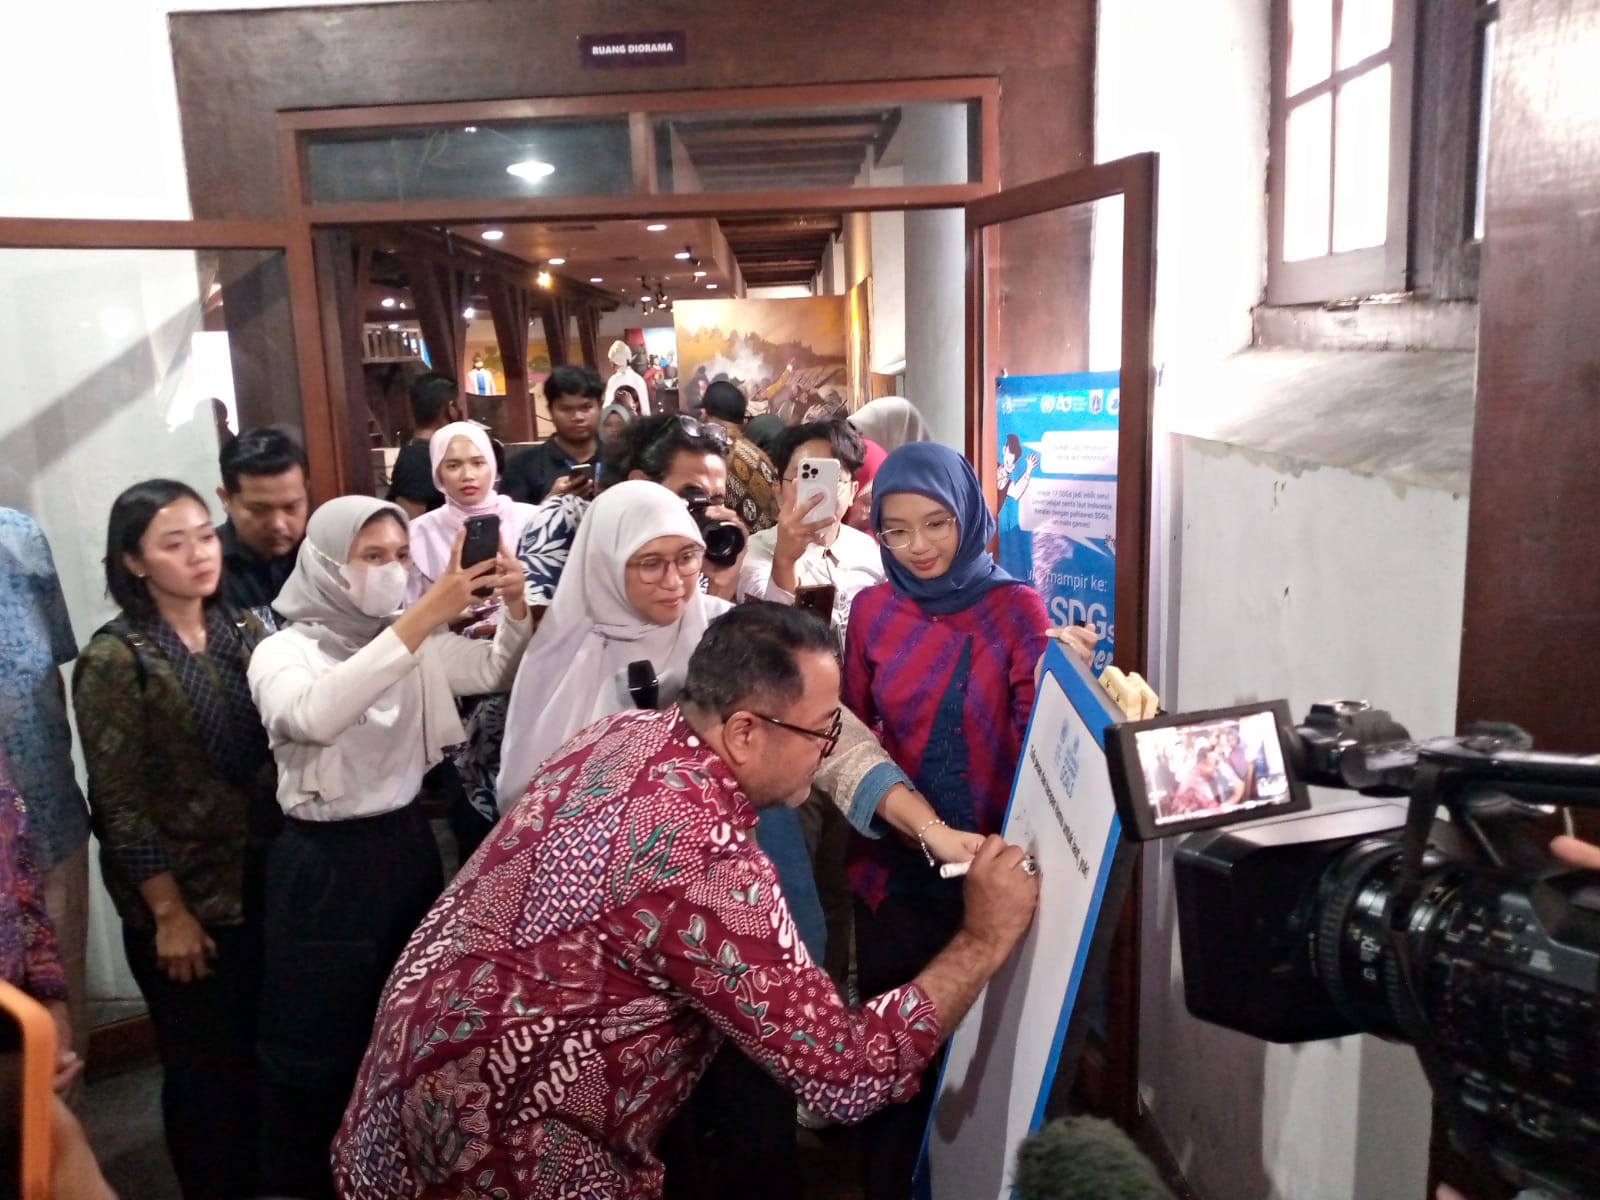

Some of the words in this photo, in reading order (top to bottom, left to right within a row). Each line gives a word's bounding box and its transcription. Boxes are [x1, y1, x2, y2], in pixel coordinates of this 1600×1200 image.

[592, 45, 626, 55] RUANG
[627, 43, 674, 53] DIORAMA
[1046, 571, 1089, 591] mampir
[1091, 574, 1108, 593] ke:
